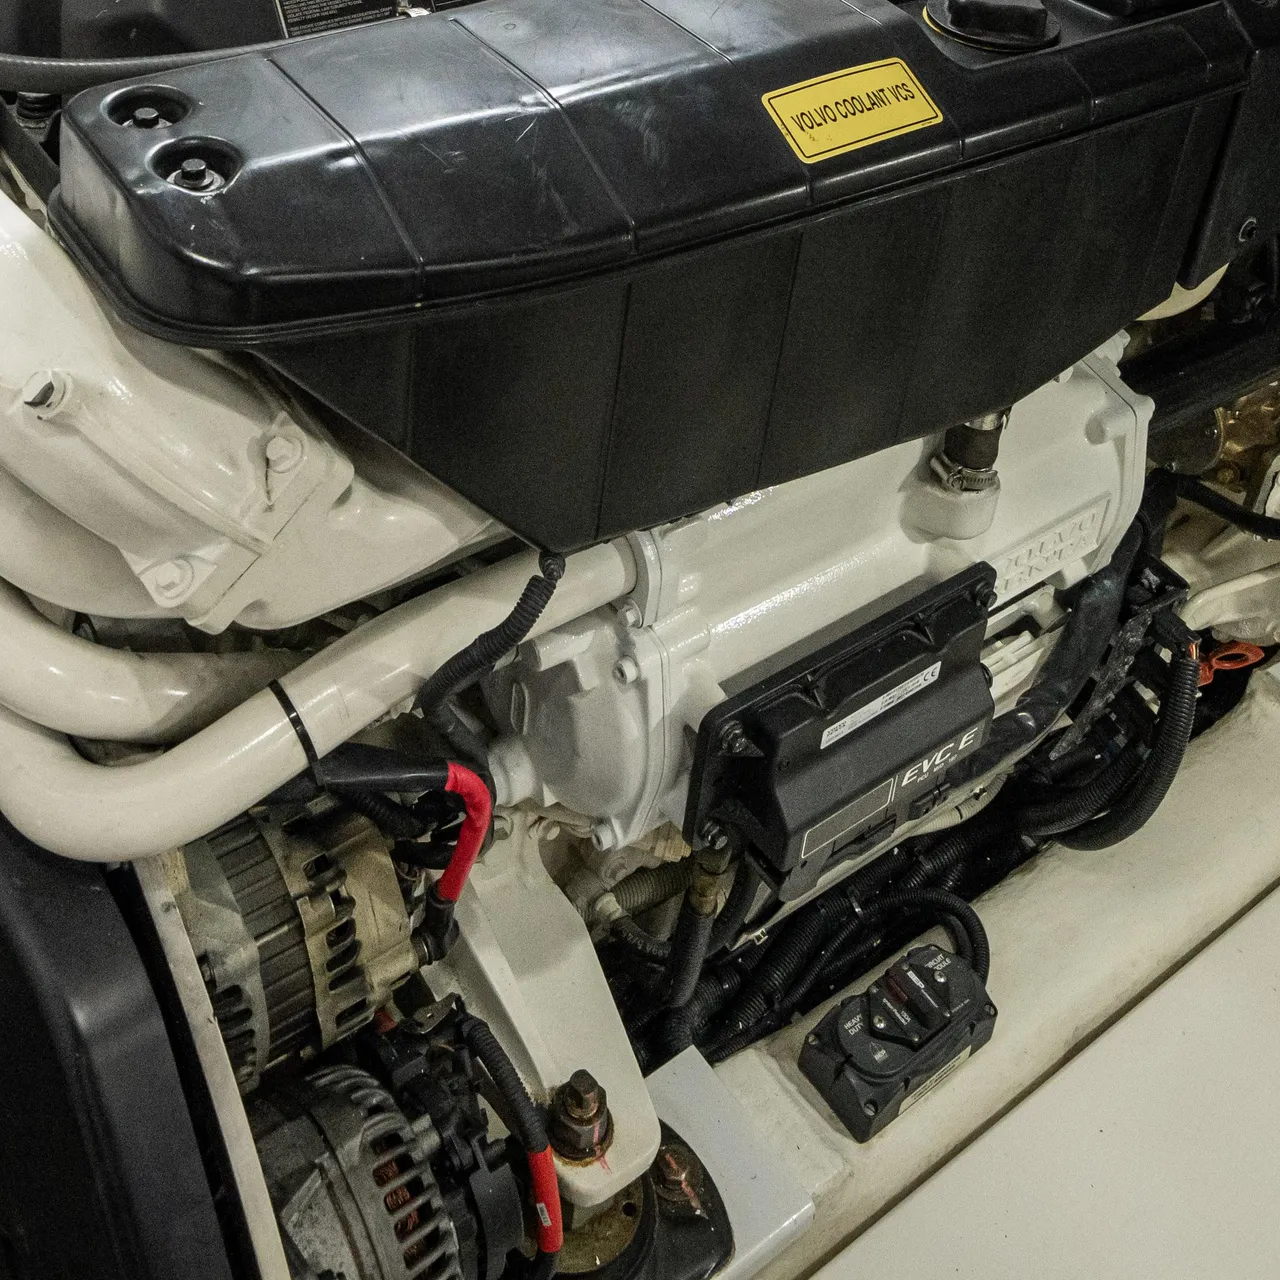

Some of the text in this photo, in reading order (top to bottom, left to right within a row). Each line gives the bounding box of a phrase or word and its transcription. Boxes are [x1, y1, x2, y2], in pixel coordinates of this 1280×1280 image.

[790, 82, 915, 132] VOLVO COOLANT VCS
[902, 727, 978, 787] EVC E
[924, 954, 945, 968] IRCUIT
[844, 1014, 863, 1030] HEAVY
[848, 1022, 864, 1036] DUTY
